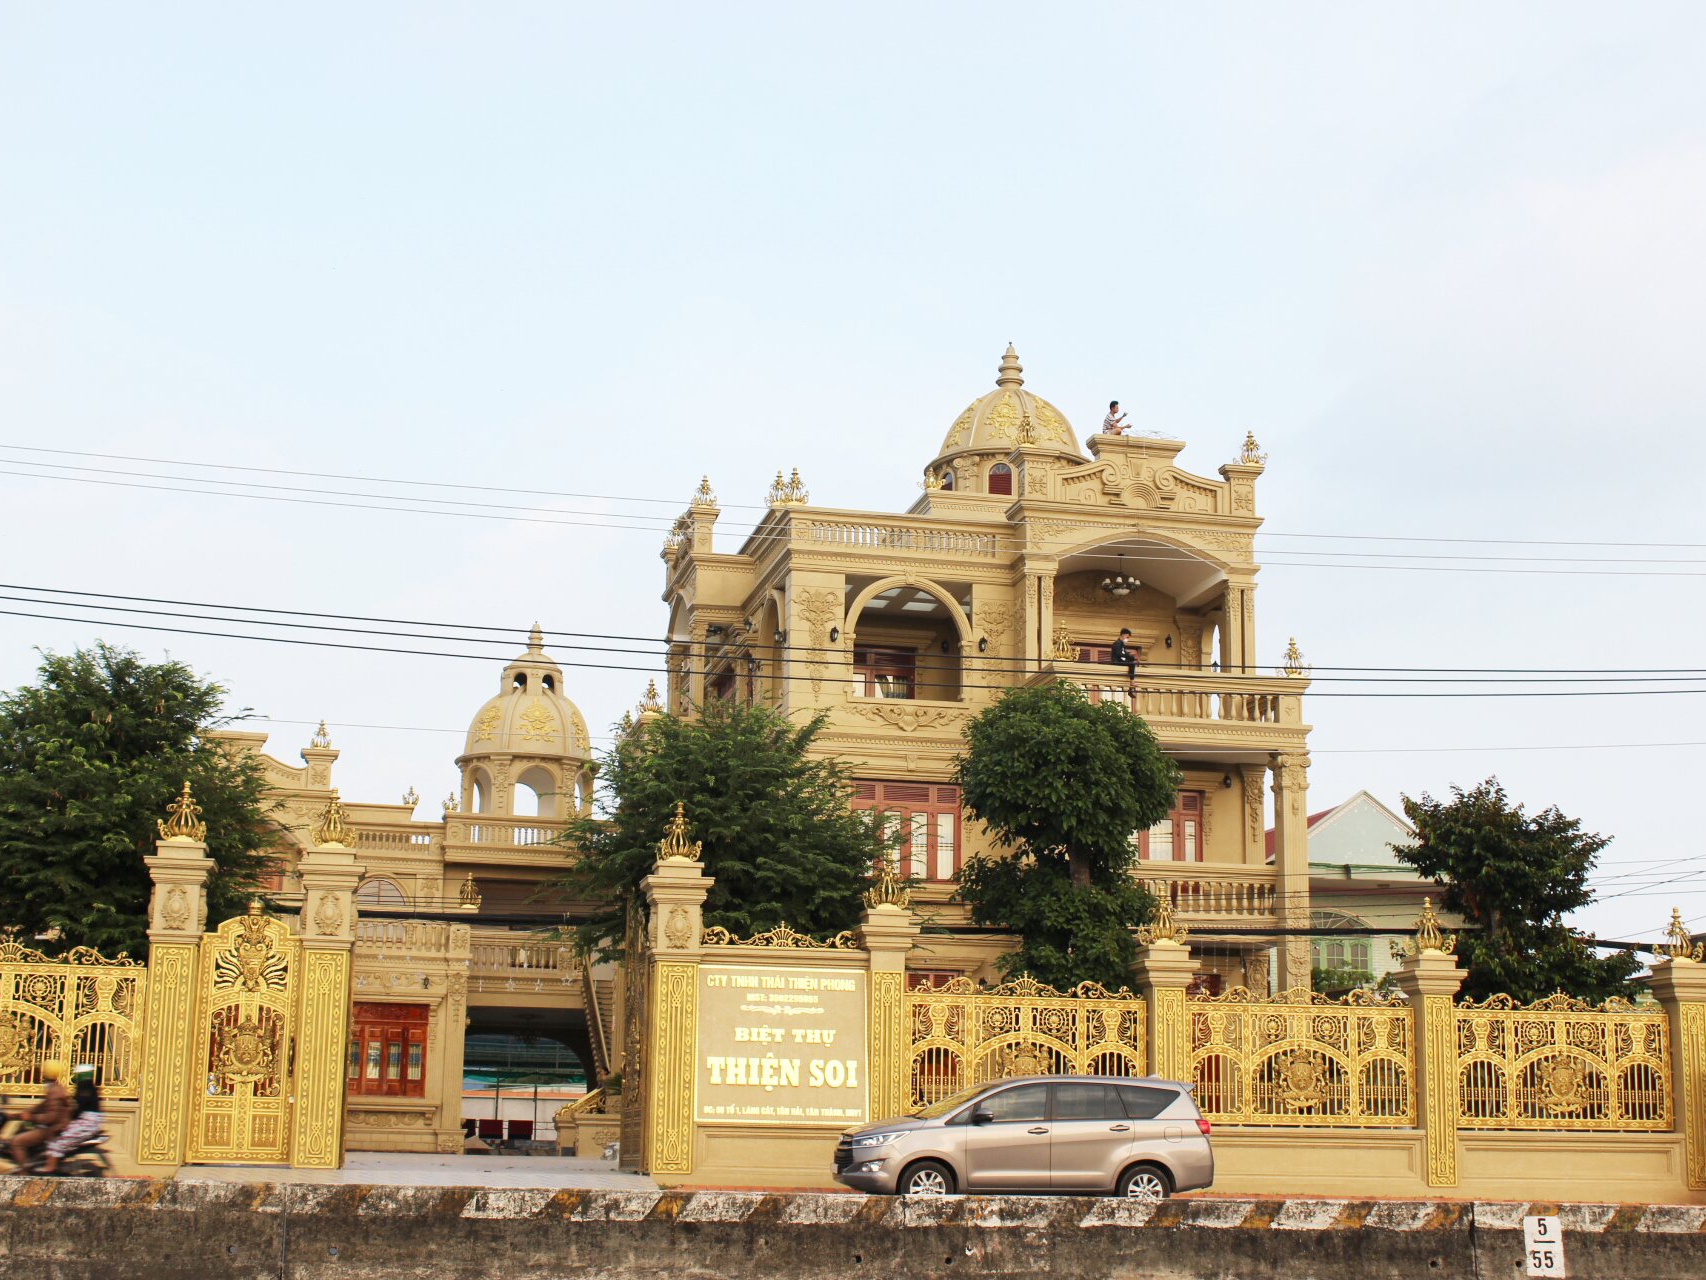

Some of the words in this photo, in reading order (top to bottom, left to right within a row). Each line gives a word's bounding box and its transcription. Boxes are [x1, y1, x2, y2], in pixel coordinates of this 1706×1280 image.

[707, 975, 727, 987] CTY
[731, 976, 758, 988] TNHH
[820, 978, 856, 991] PHONG
[734, 1024, 786, 1046] BIỆT
[706, 1052, 801, 1092] THIỆN
[809, 1059, 858, 1088] SOI
[1537, 1217, 1548, 1236] 5
[1532, 1250, 1554, 1269] 55
